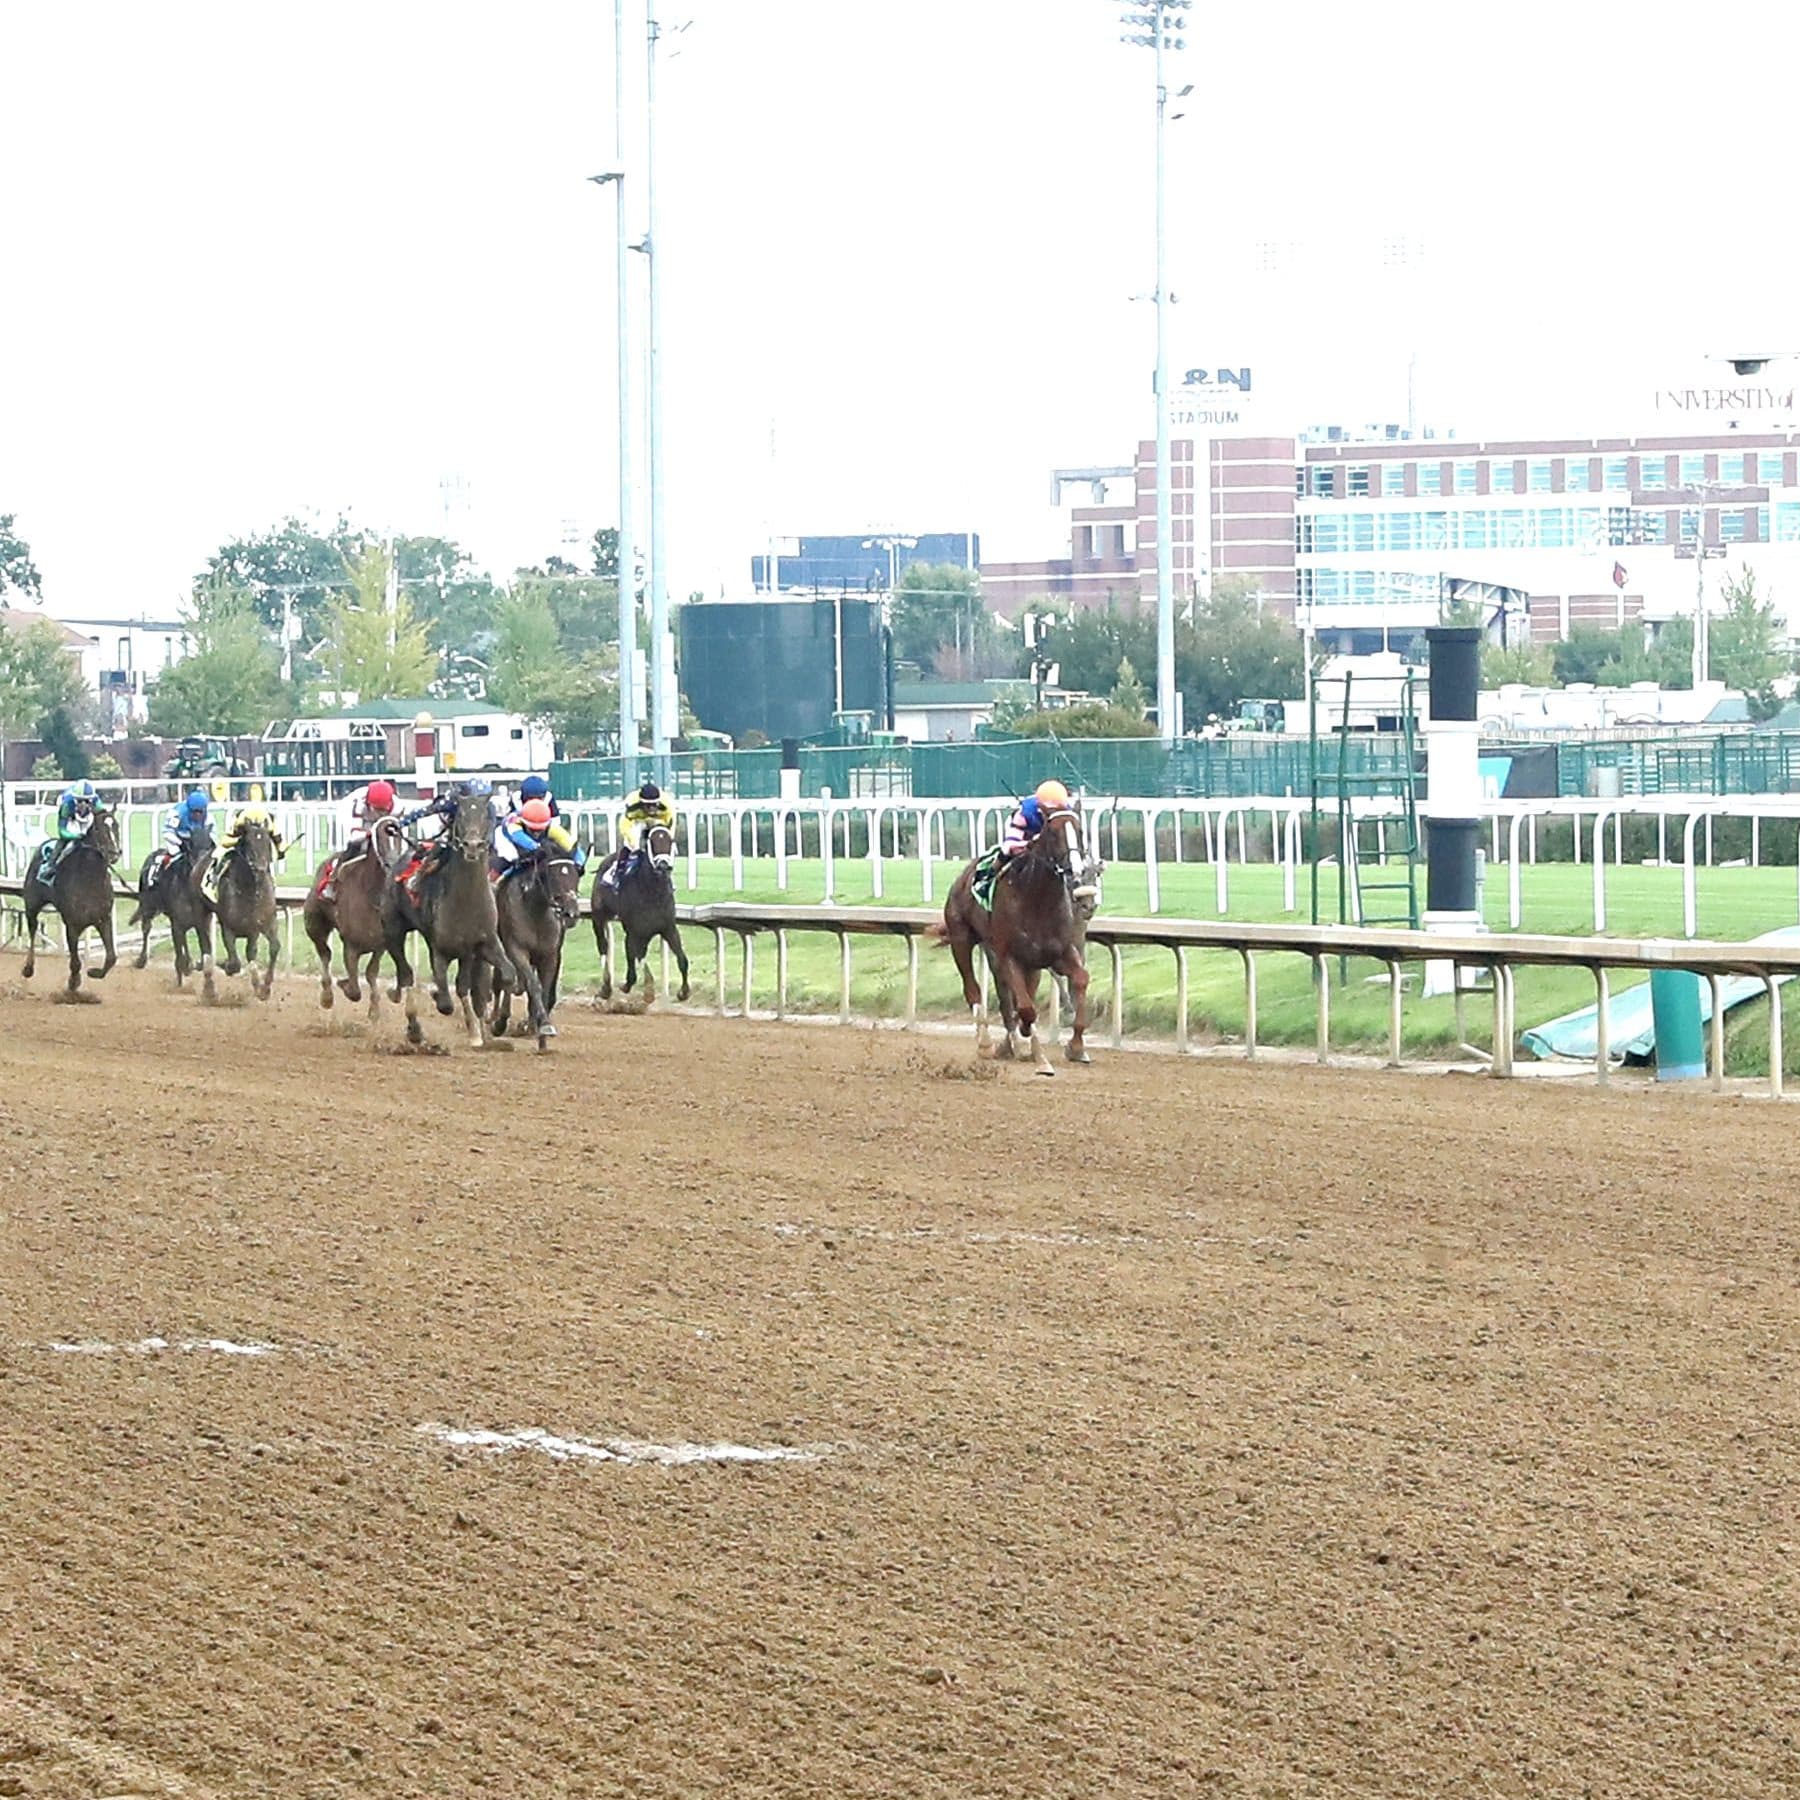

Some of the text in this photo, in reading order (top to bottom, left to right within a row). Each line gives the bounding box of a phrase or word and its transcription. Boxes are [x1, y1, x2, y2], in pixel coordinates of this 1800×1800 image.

[1153, 368, 1251, 394] &N
[1655, 387, 1775, 410] UNIVERSITY
[1170, 411, 1239, 424] STADIUM
